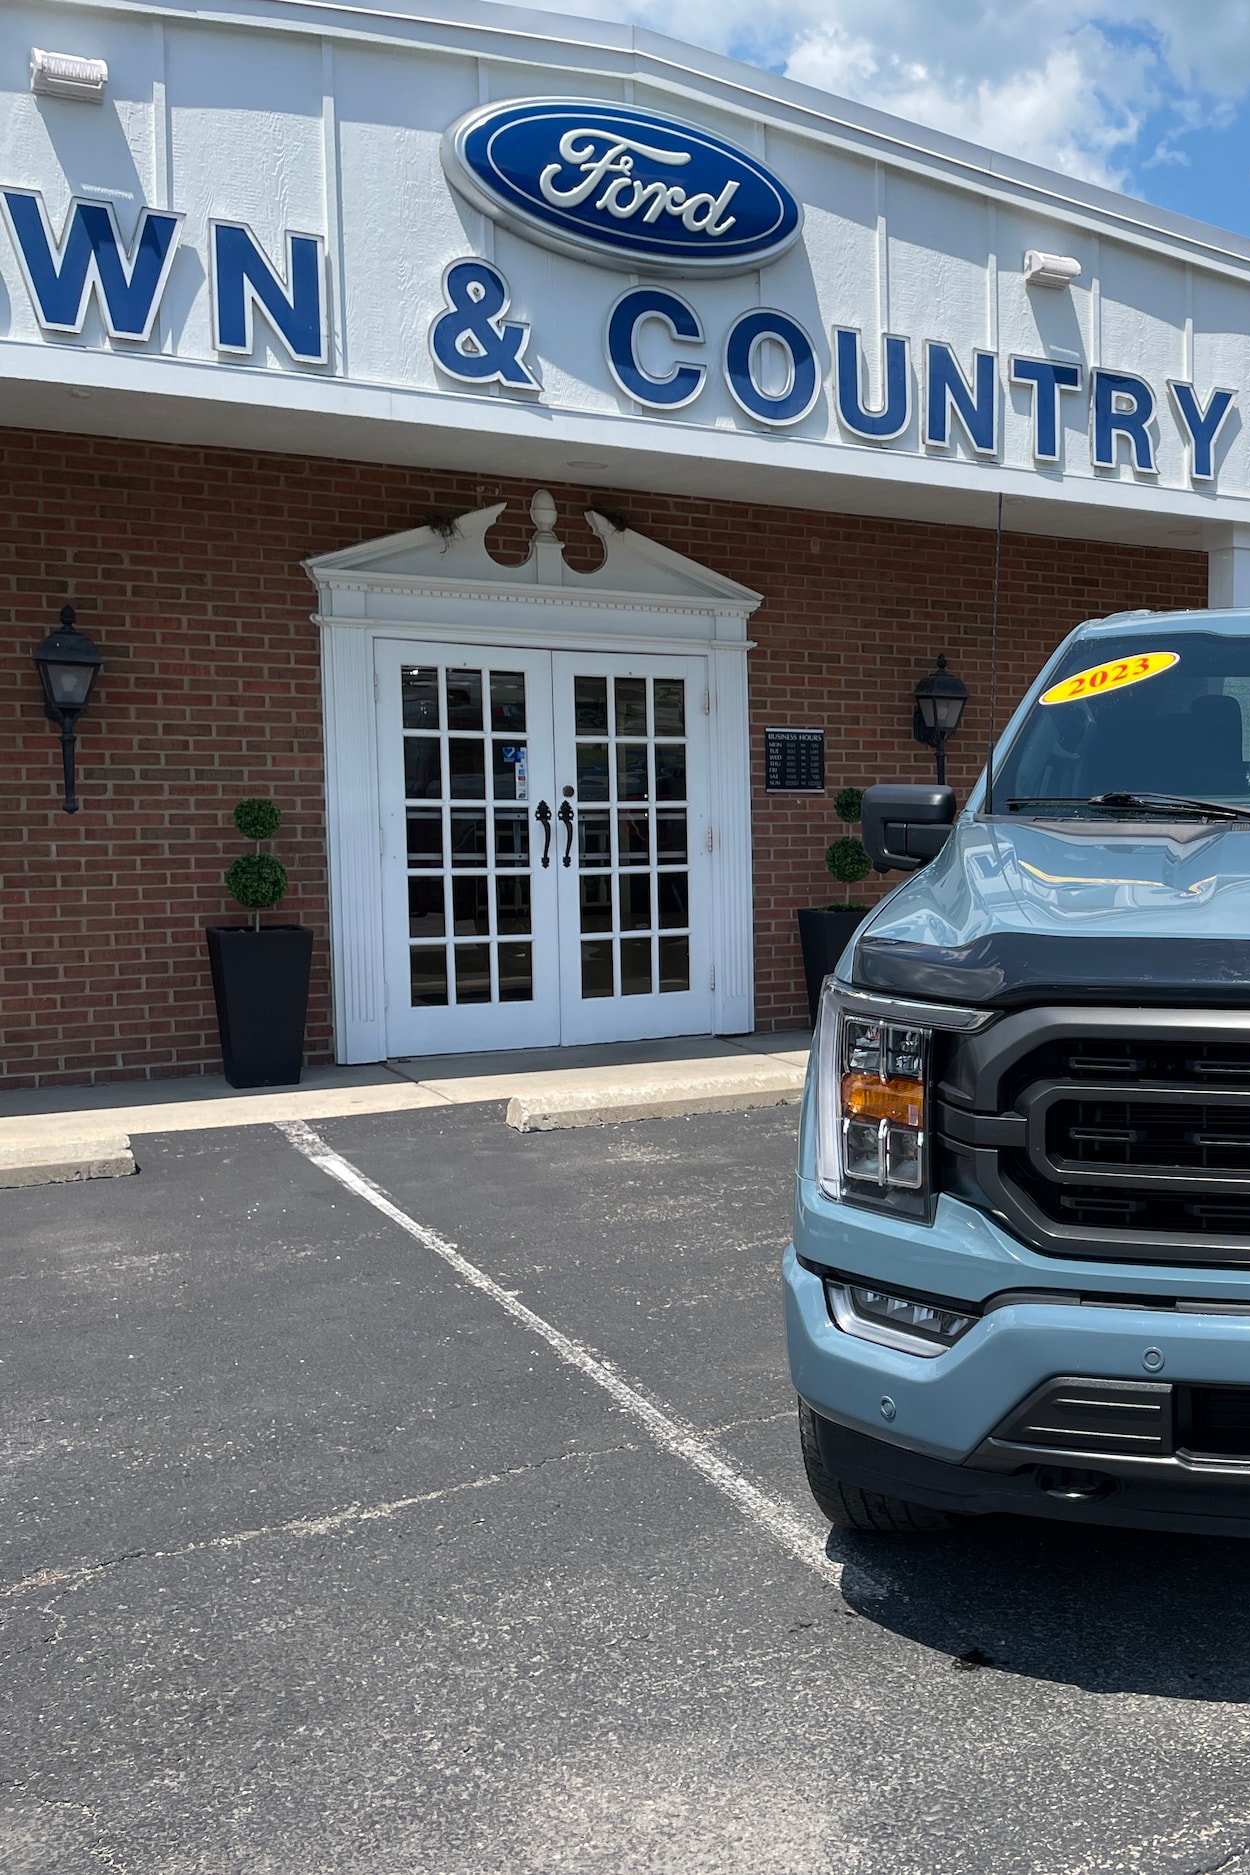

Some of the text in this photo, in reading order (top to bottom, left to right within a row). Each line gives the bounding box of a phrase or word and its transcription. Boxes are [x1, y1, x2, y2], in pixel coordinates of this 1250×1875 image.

[538, 127, 742, 238] Ford
[428, 256, 543, 392] &
[606, 285, 1240, 481] COUNTRY
[1068, 657, 1150, 697] 2023
[768, 733, 822, 742] BUSINESS HOURS
